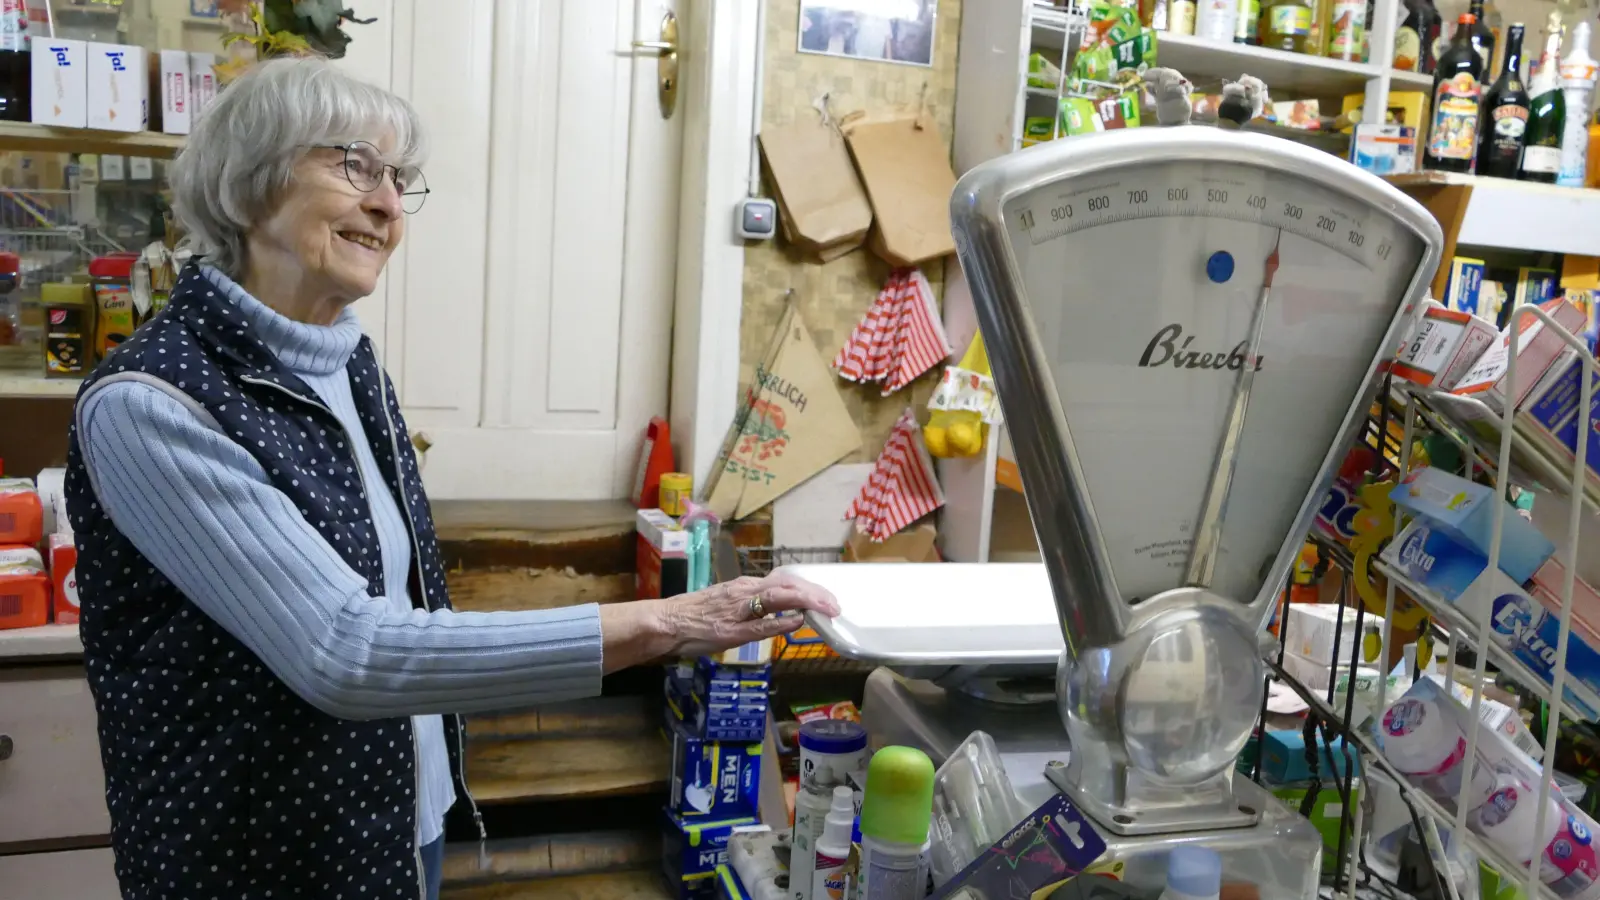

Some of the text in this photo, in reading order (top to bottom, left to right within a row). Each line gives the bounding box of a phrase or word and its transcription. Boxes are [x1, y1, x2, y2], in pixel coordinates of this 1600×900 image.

[49, 47, 71, 67] ja!
[105, 52, 126, 72] ja!
[1050, 204, 1073, 222] 900
[1088, 195, 1110, 212] 800
[1127, 190, 1148, 204] 700
[1167, 187, 1188, 201] 600
[1207, 188, 1228, 204] 500
[1246, 194, 1267, 210] 400
[1283, 203, 1303, 220] 300
[1316, 215, 1337, 233] 200
[1348, 229, 1365, 247] 100
[1406, 321, 1434, 362] PILOT
[1401, 531, 1436, 571] Extra
[1494, 602, 1557, 665] Extra
[722, 755, 738, 803] MEN
[699, 852, 729, 867] ME
